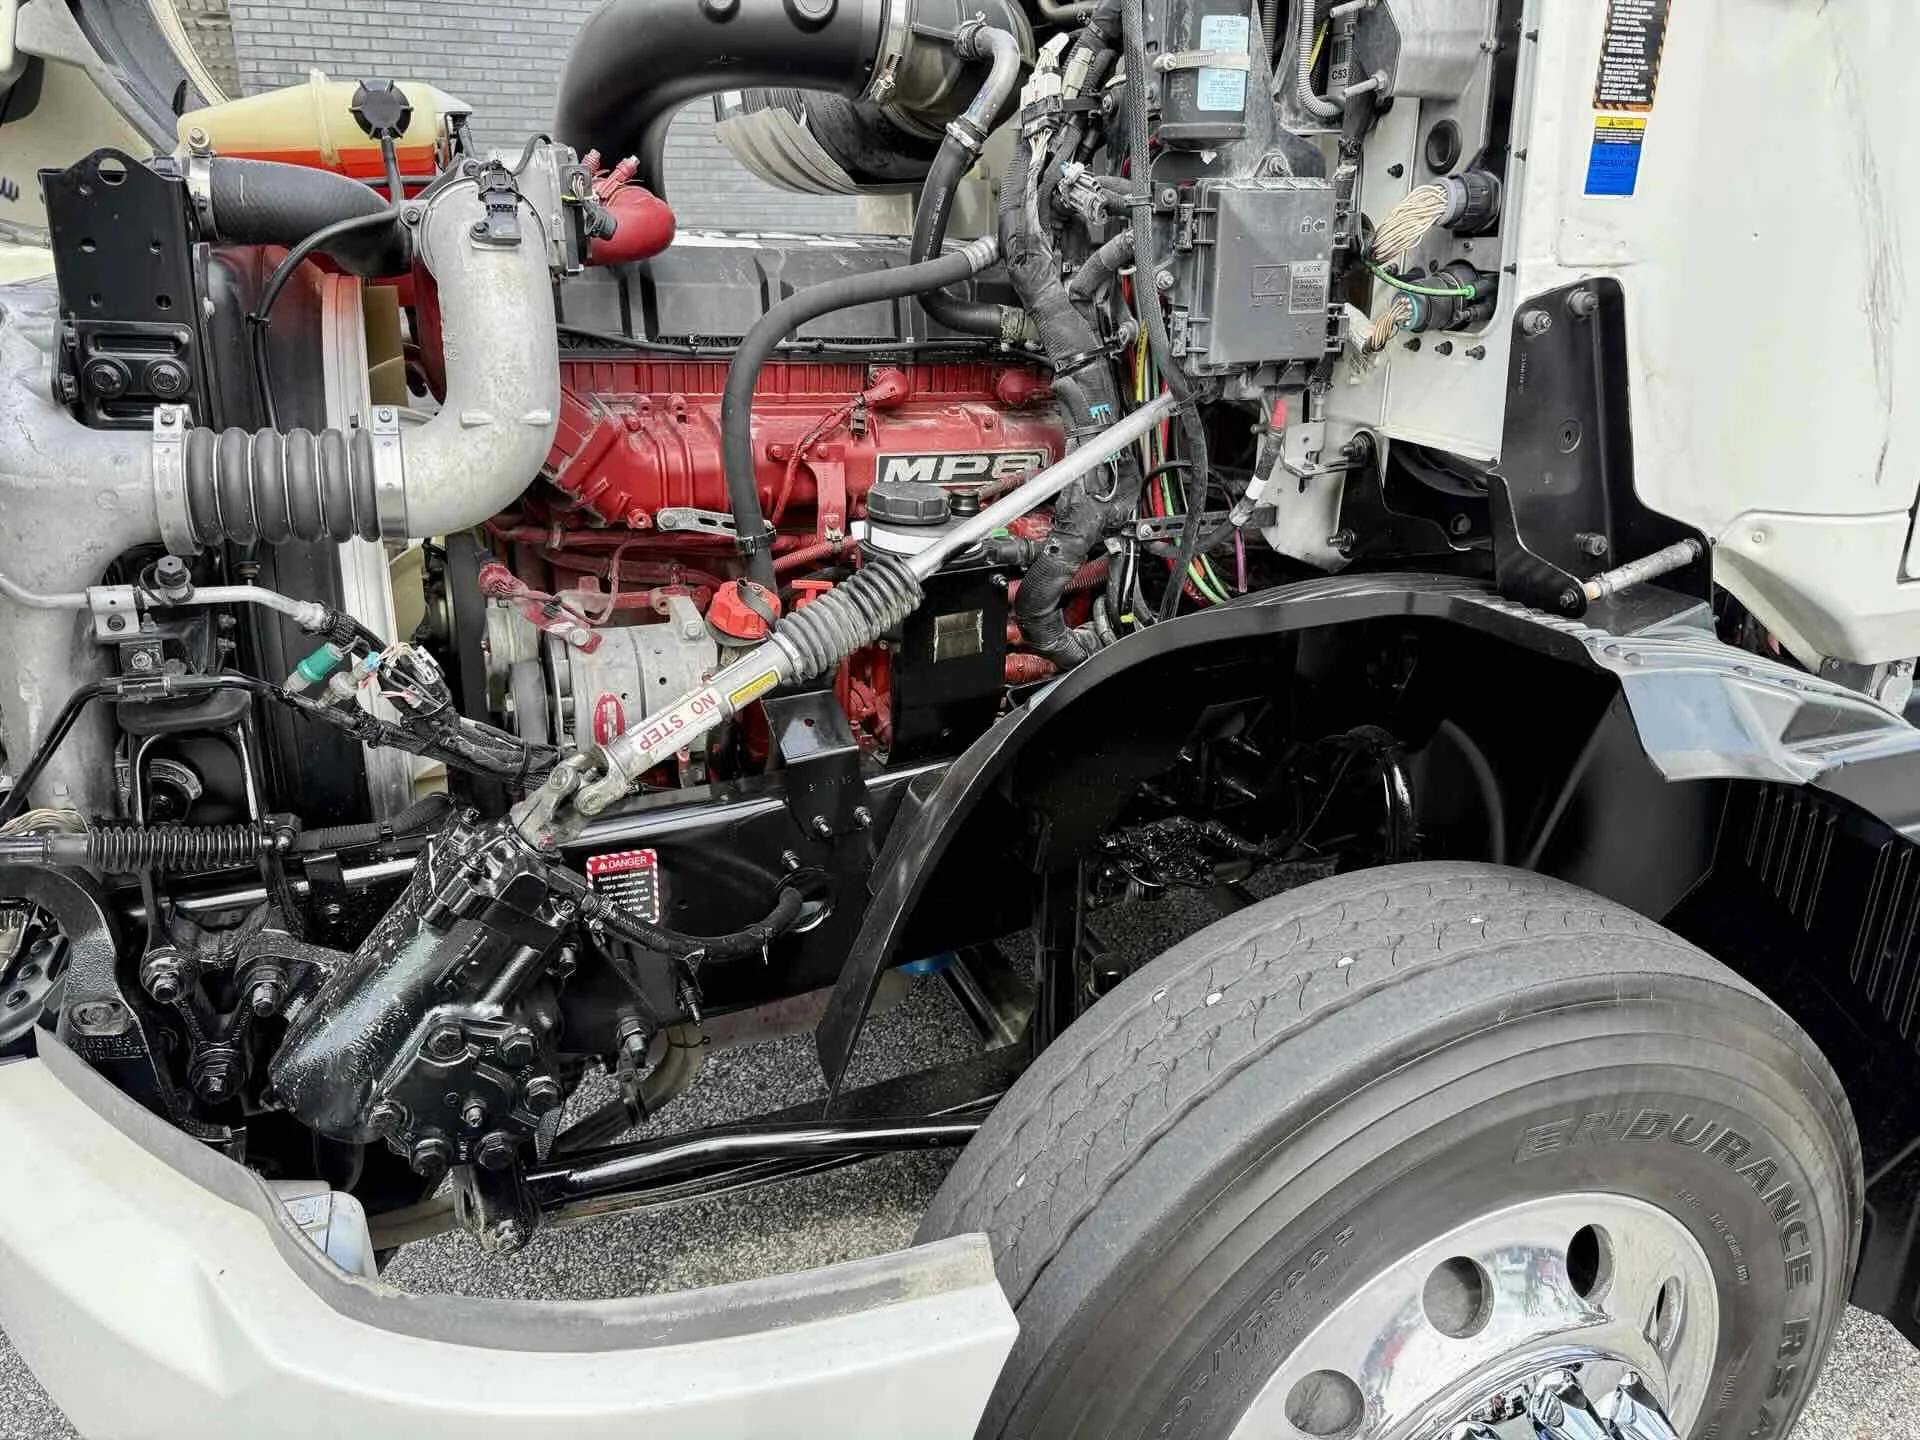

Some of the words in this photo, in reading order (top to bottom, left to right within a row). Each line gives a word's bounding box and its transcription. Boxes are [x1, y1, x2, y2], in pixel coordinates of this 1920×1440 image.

[691, 692, 717, 716] NO
[639, 713, 685, 751] STEP
[608, 856, 648, 869] DANGER
[1511, 1108, 1814, 1291] ENDURANCE
